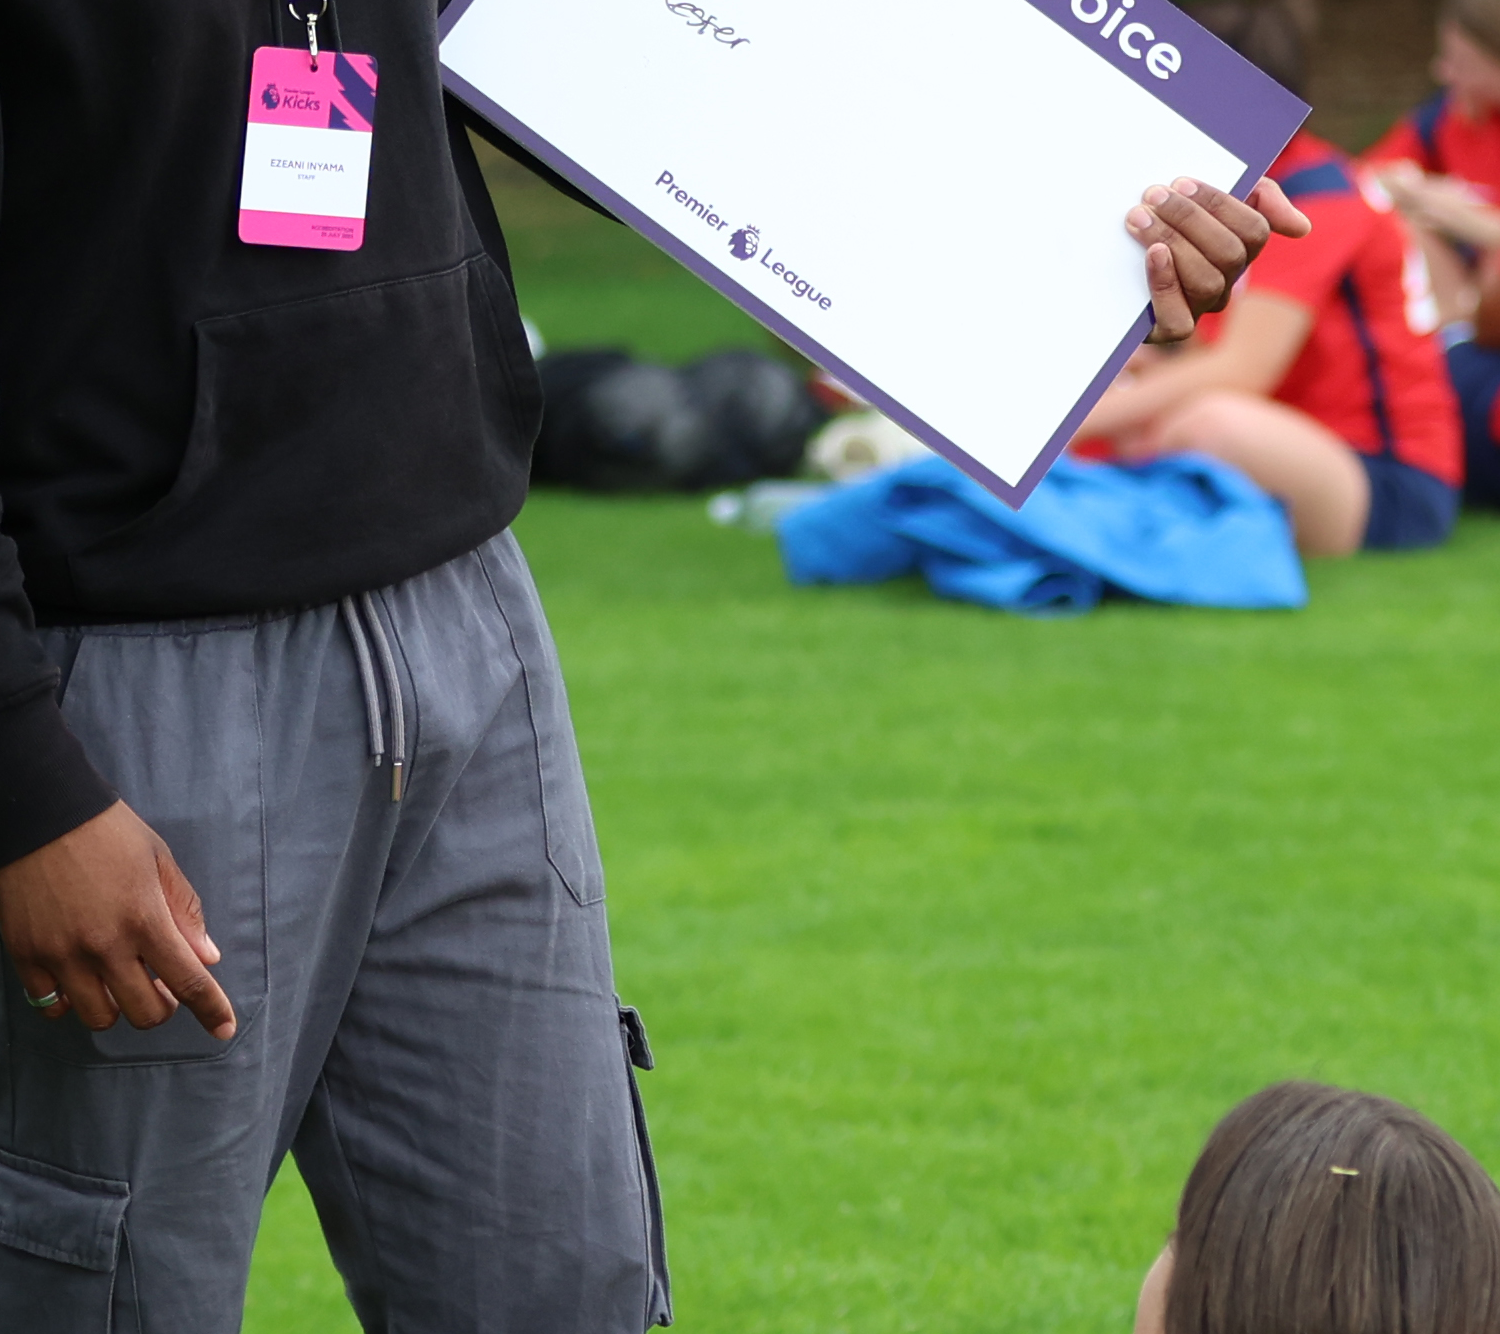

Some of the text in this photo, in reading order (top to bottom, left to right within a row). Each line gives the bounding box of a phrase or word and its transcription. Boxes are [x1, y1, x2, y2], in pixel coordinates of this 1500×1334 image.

[282, 95, 320, 111] Kicks
[270, 158, 344, 173] EZEANI INYAMA
[655, 169, 832, 311] Premier League
